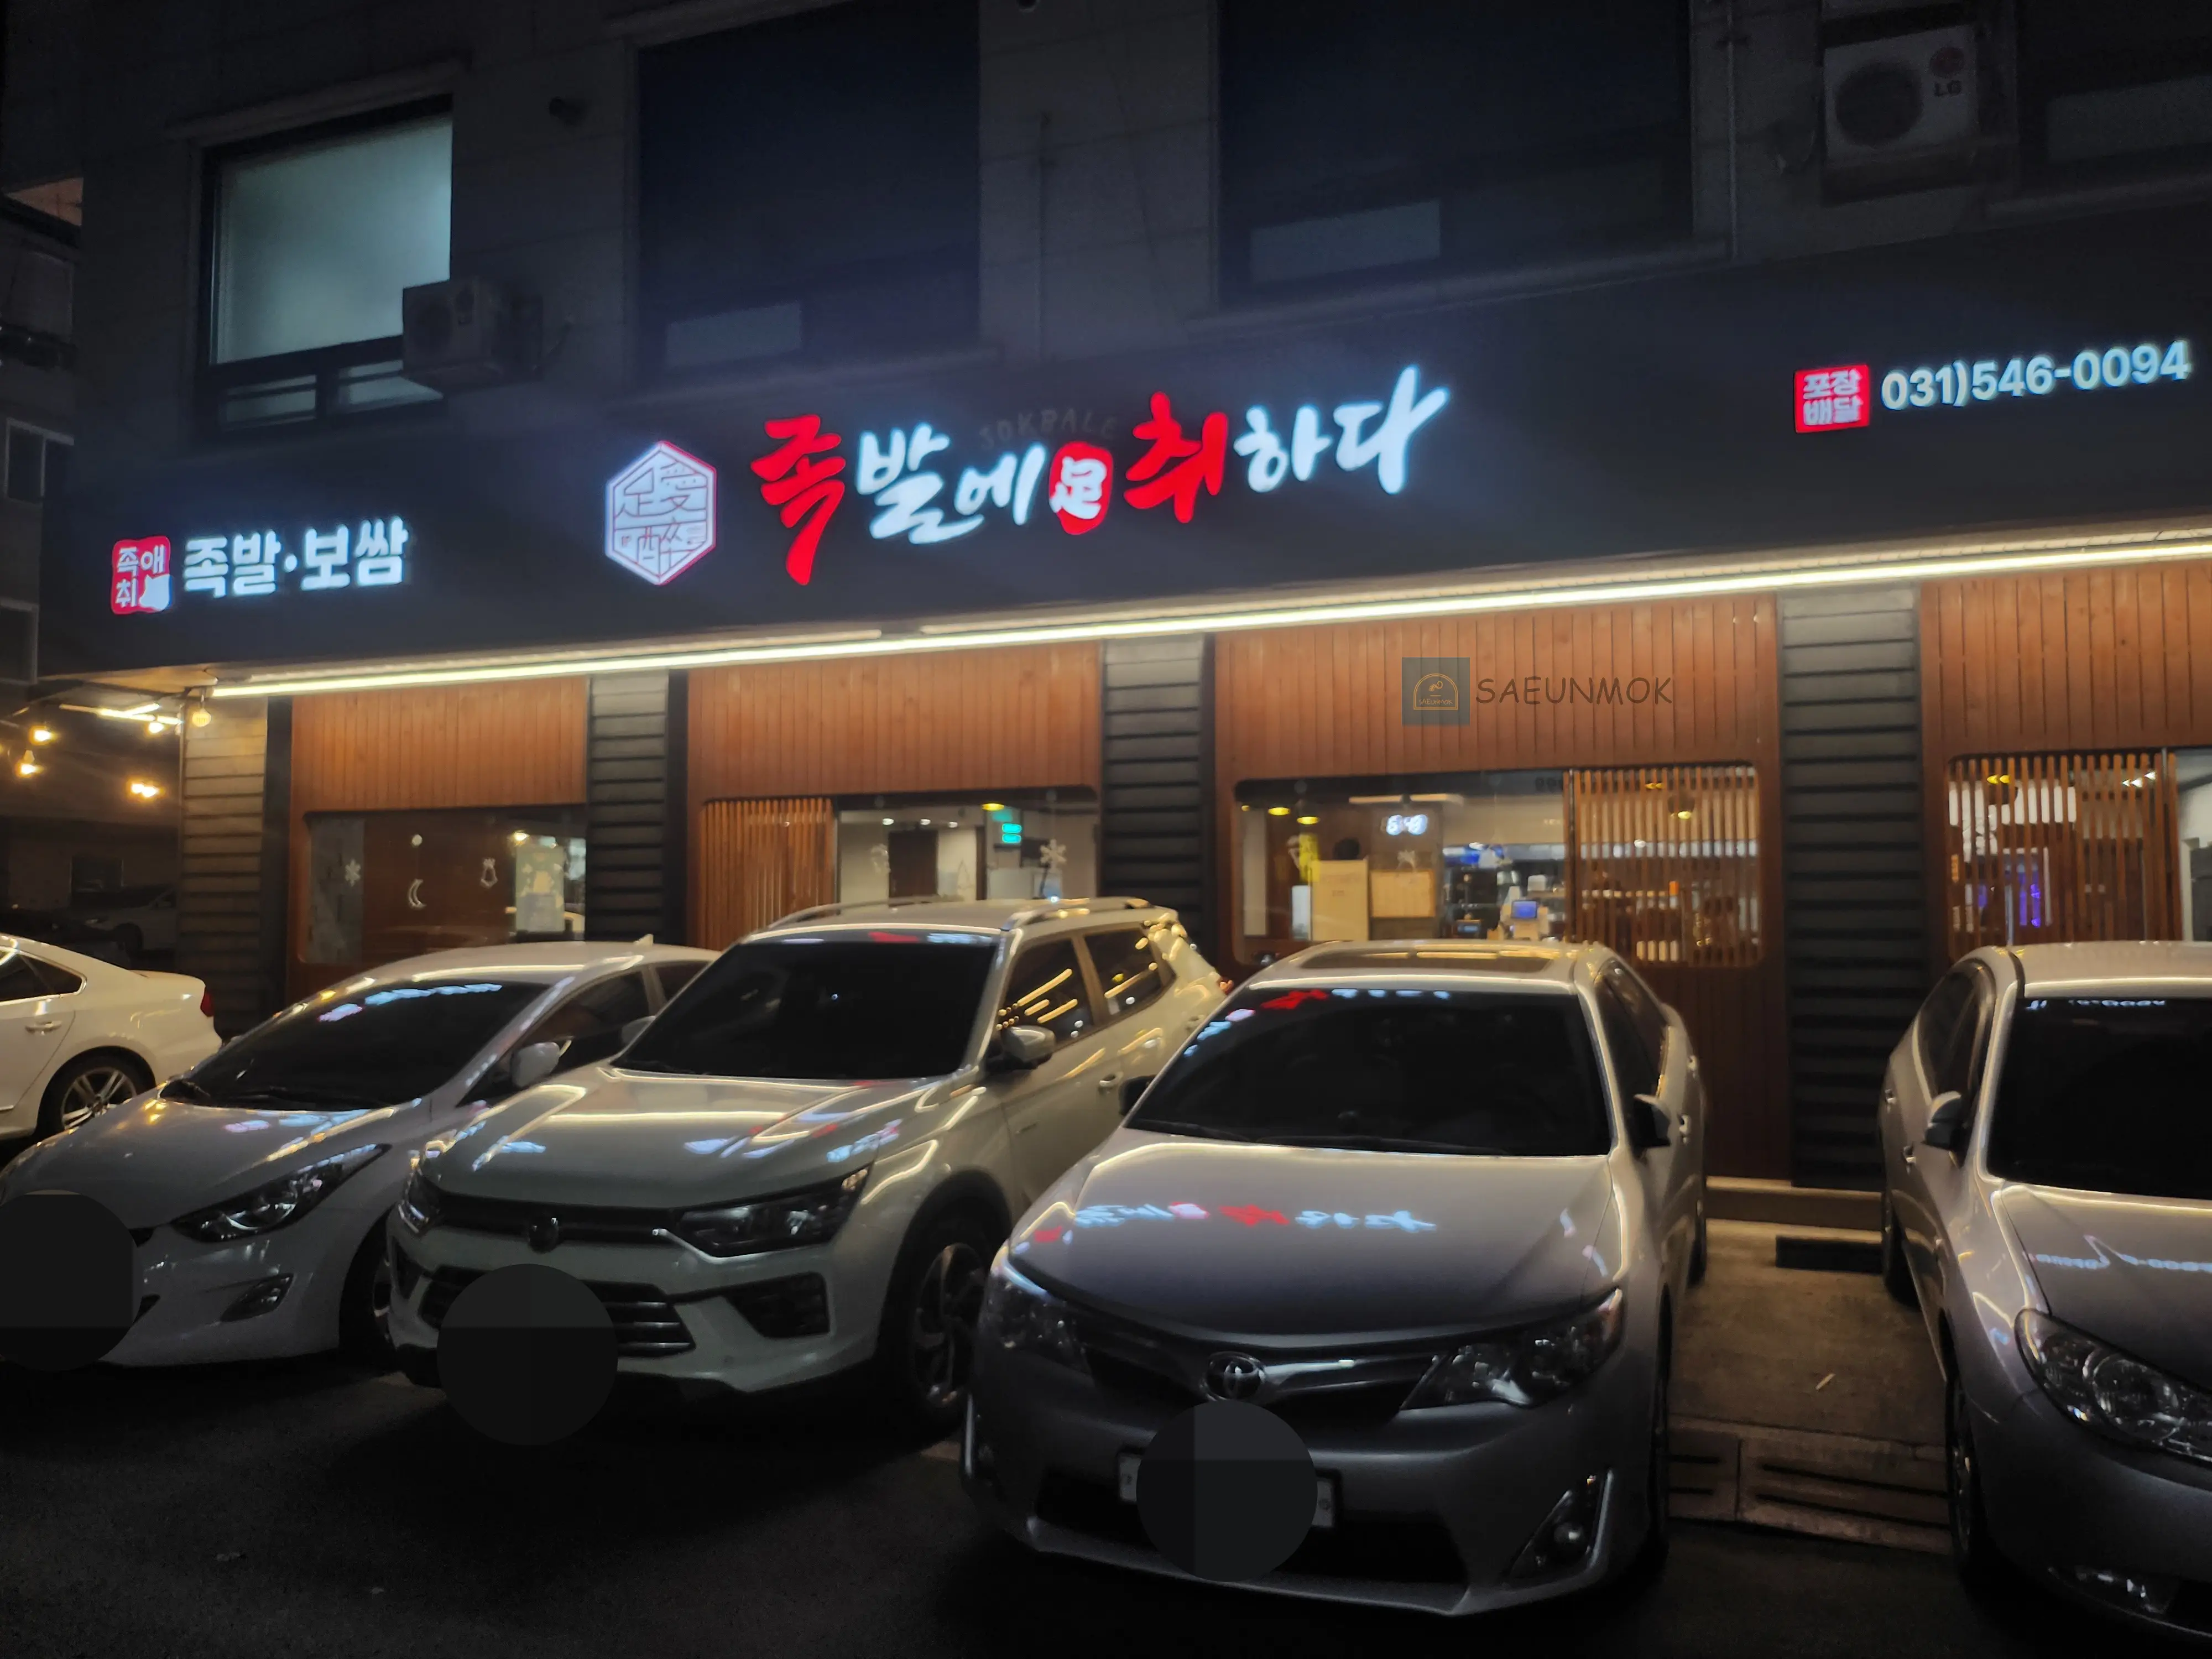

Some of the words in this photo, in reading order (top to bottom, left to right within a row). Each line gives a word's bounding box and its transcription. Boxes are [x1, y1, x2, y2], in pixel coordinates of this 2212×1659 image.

[1934, 80, 1962, 97] LG
[1803, 368, 1863, 399] 포장
[1881, 340, 2192, 410] 031)546-0094
[1803, 397, 1864, 426] 배달
[750, 413, 1047, 586] 족발에
[1124, 364, 1450, 523] 취하다
